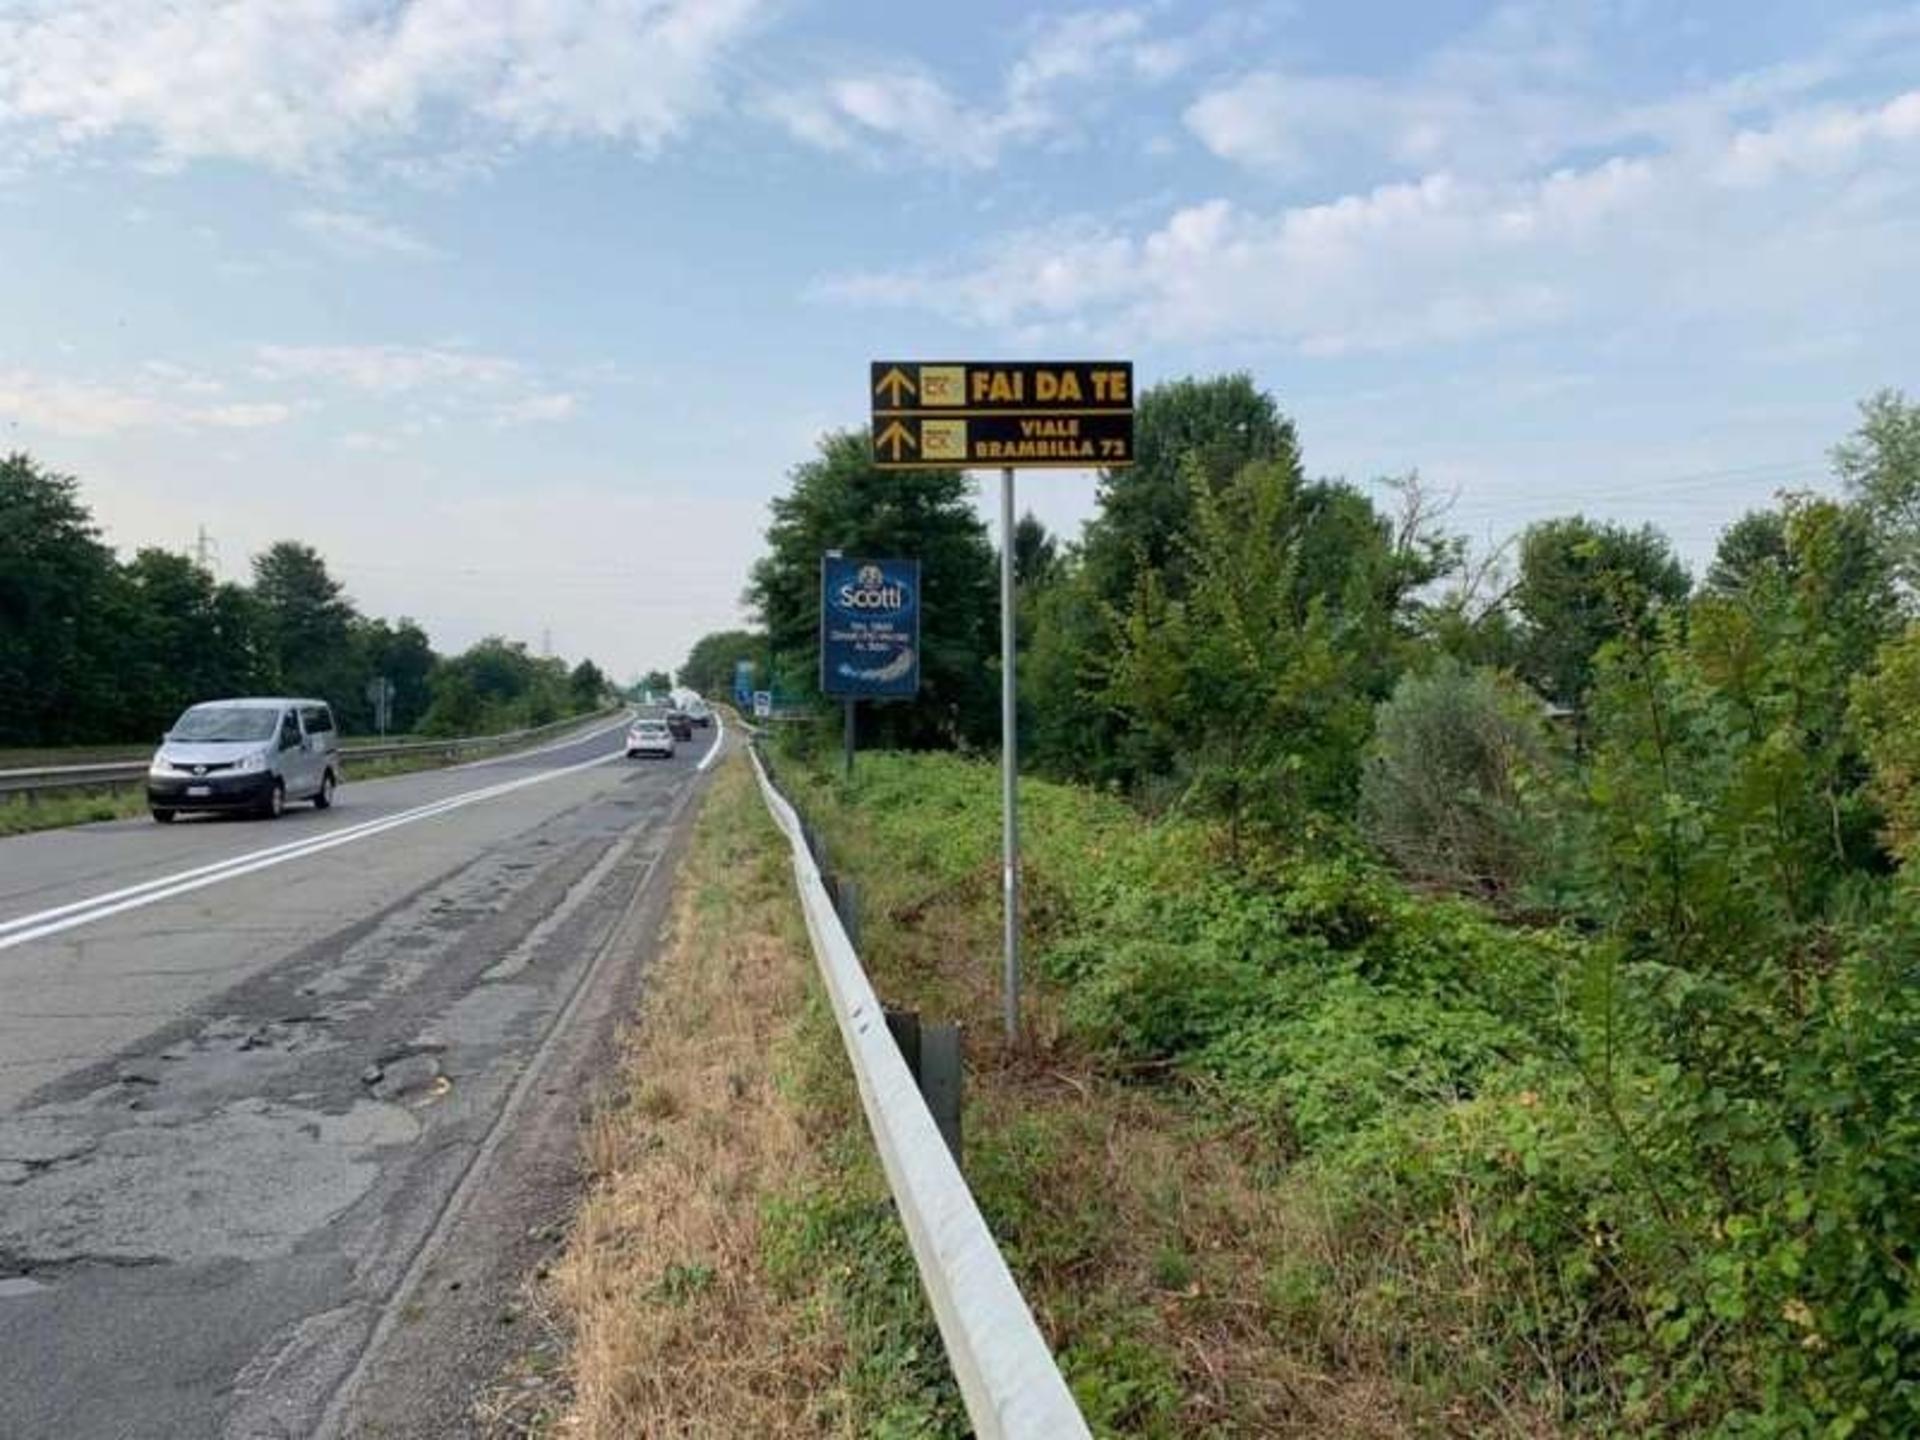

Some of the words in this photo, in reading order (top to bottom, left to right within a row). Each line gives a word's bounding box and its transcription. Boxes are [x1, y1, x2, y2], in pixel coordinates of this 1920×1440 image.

[973, 371, 1023, 400] FAI
[1036, 370, 1083, 400] DA
[1091, 370, 1127, 400] TE
[1020, 419, 1080, 436] VIALE
[975, 440, 1094, 457] BRAMBILLA
